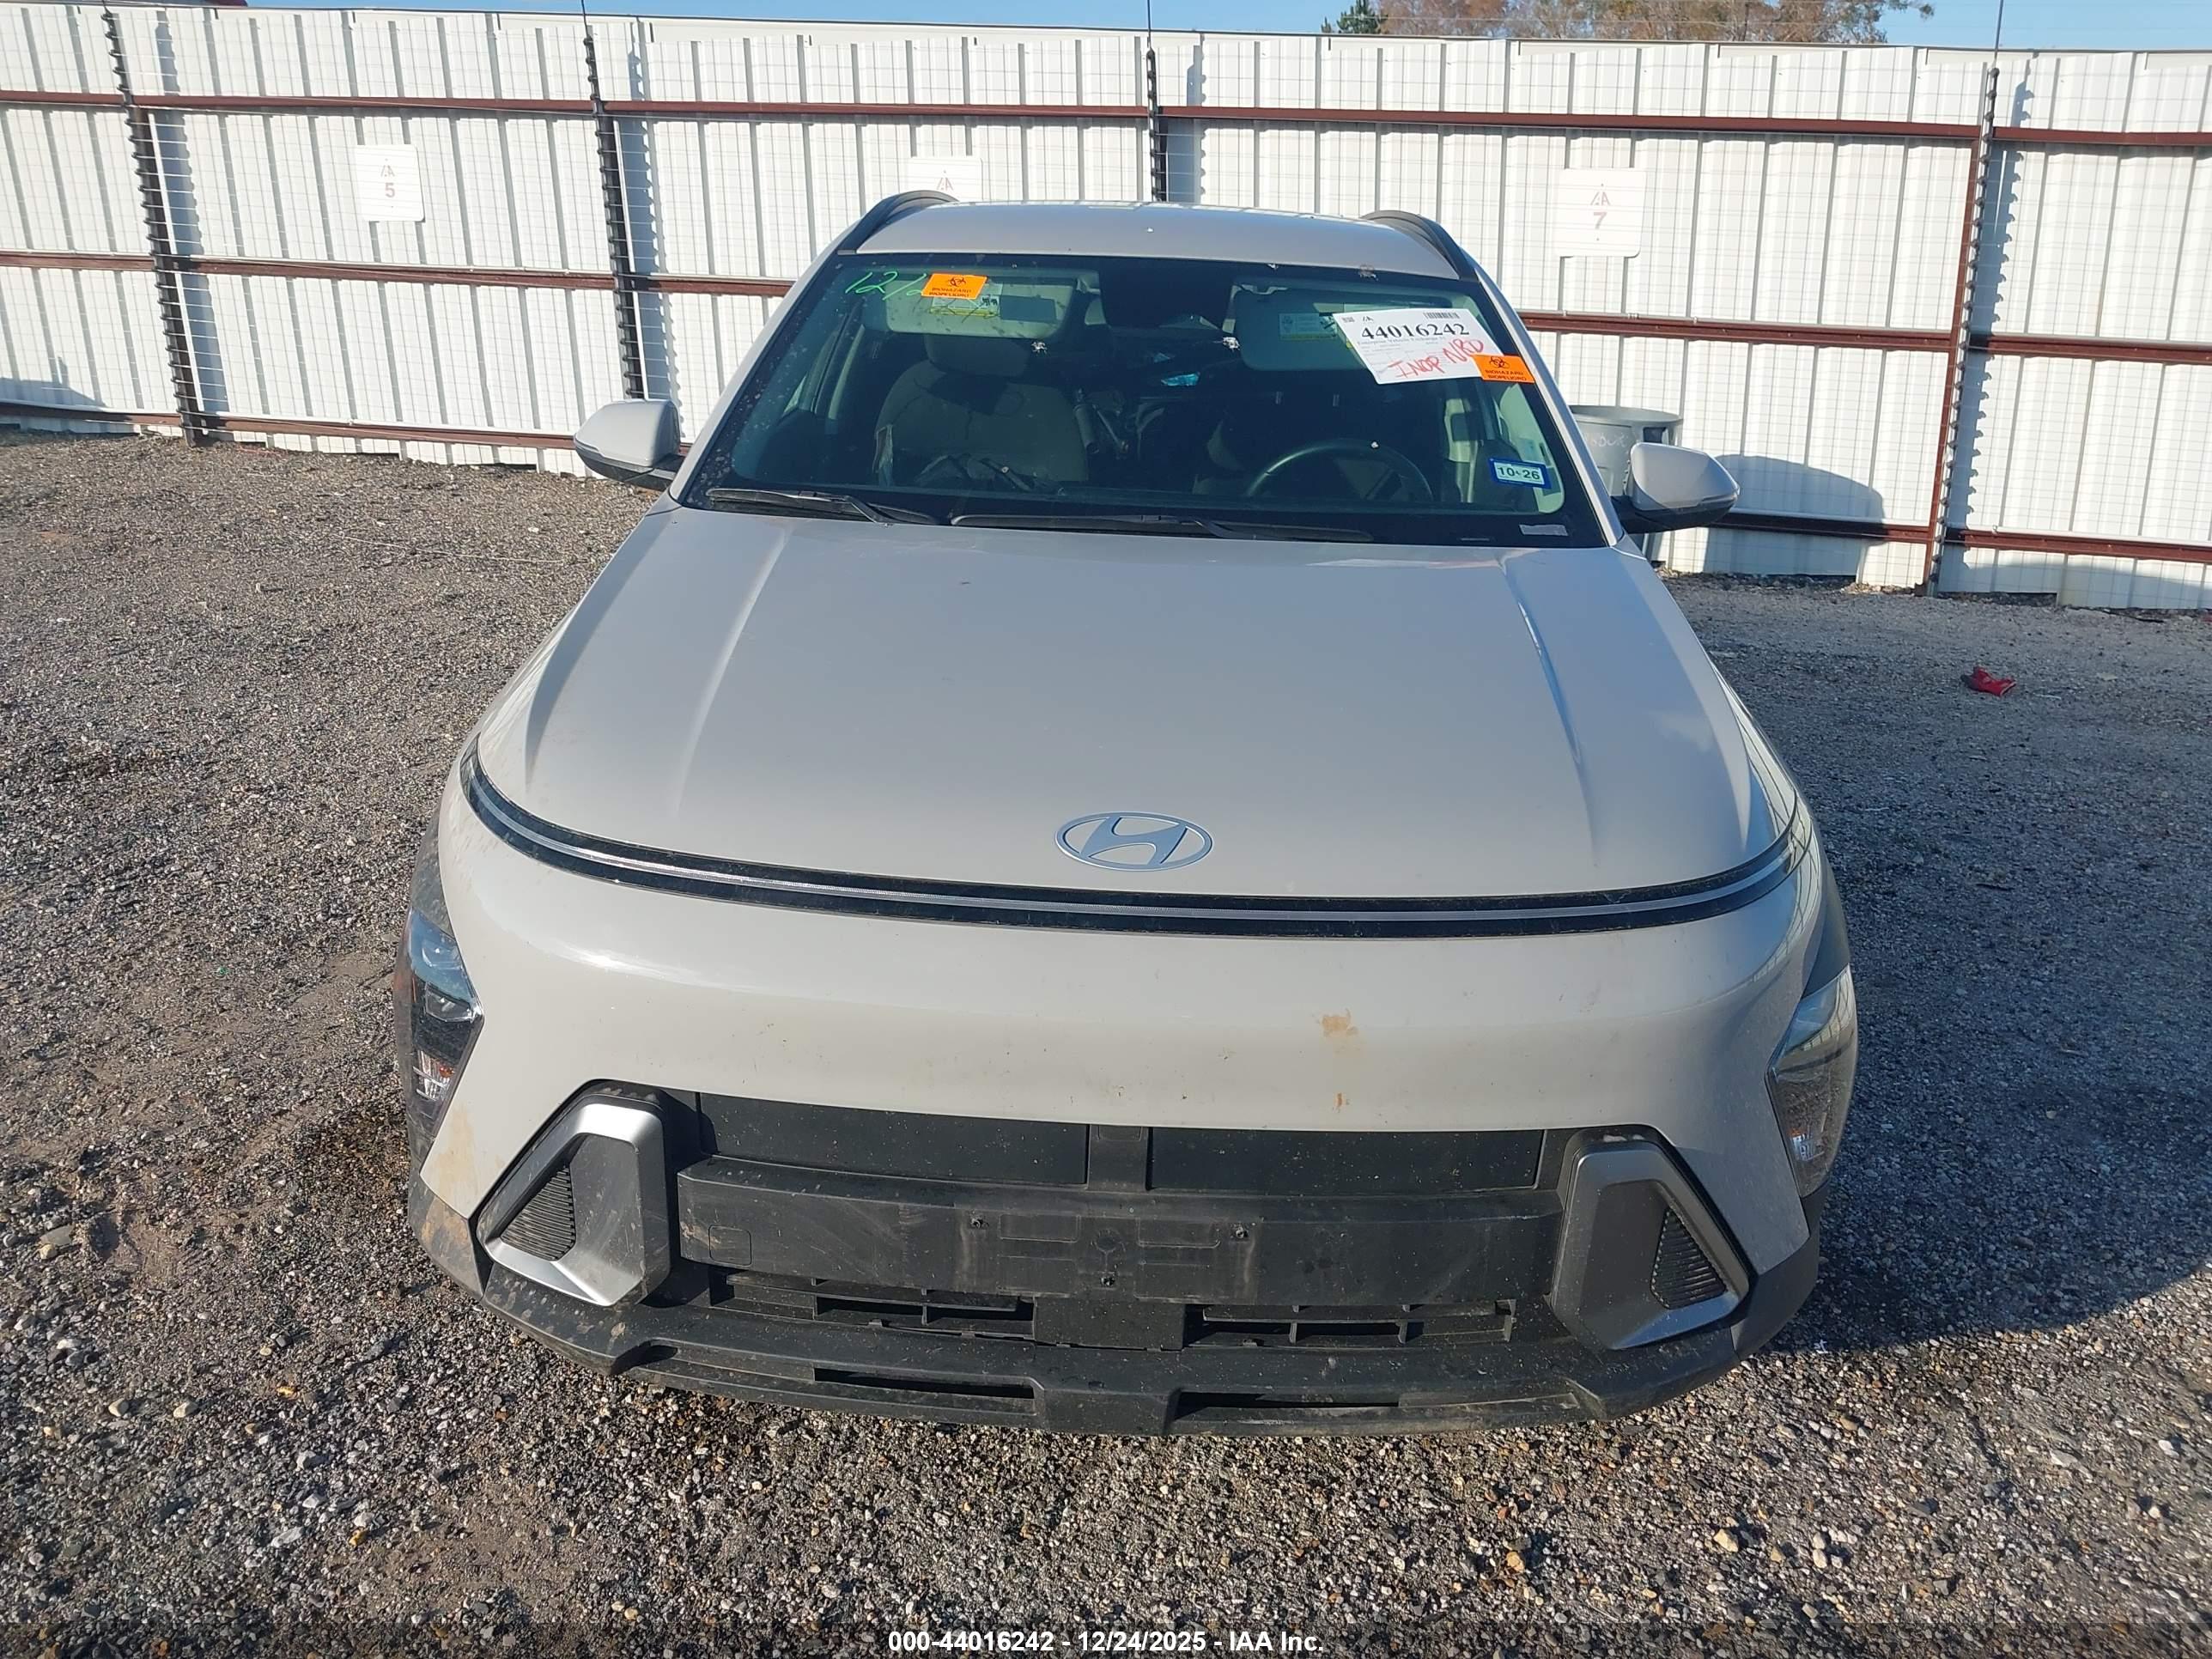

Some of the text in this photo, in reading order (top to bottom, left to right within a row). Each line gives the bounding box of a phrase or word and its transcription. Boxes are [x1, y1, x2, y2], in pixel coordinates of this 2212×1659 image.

[384, 181, 396, 198] 5
[1593, 211, 1608, 230] 7
[1361, 323, 1470, 340] 44016242
